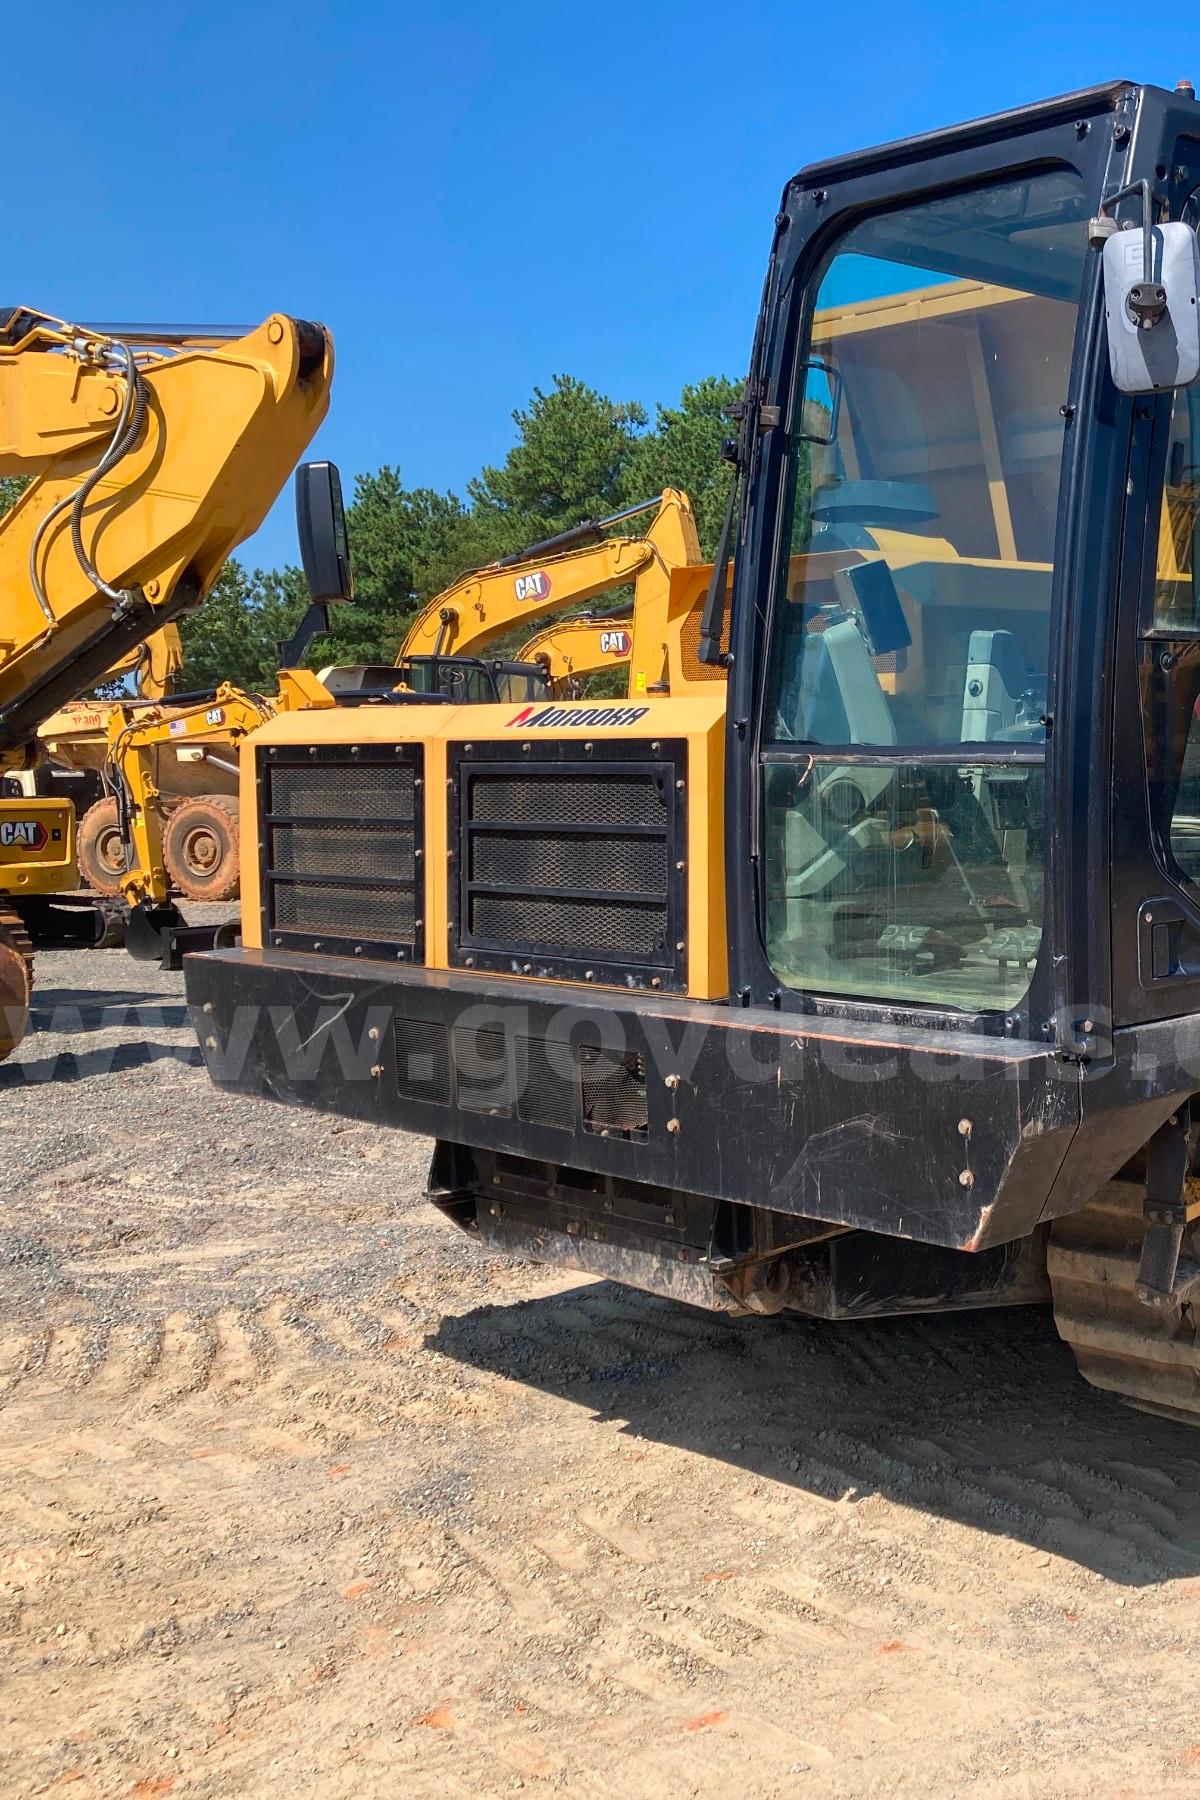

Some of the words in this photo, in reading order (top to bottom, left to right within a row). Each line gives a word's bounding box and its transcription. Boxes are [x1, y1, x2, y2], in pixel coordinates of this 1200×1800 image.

[514, 572, 542, 601] CAT
[600, 632, 625, 653] CAT
[206, 709, 222, 726] CAT
[504, 706, 650, 728] MOROOKA
[0, 821, 37, 847] CAT
